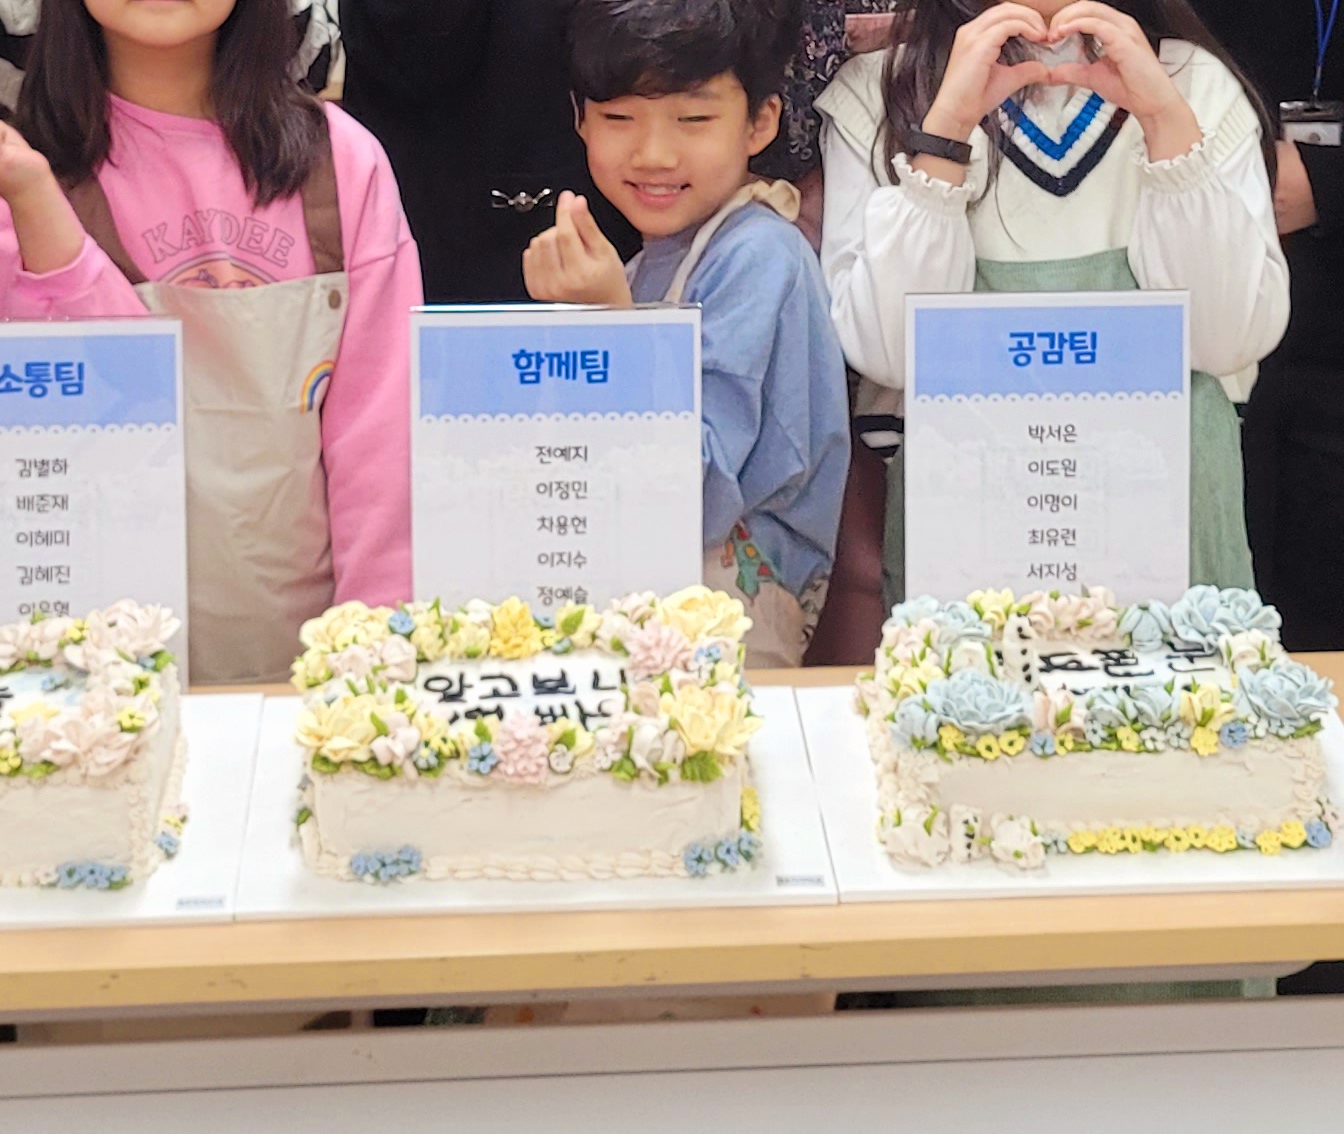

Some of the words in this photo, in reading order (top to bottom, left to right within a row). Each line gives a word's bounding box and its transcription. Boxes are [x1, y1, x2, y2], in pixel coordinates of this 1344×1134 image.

[141, 208, 296, 269] KAYDEE
[1008, 331, 1098, 367] 공감팀
[511, 348, 609, 385] 함께팀
[1028, 424, 1078, 444] 박서은
[535, 445, 588, 465] 전예지
[1027, 459, 1077, 478] 이도원
[535, 480, 588, 500] 이정민
[15, 493, 69, 514] 배준재
[537, 551, 588, 569] 이지수
[1027, 563, 1078, 582] 서지성
